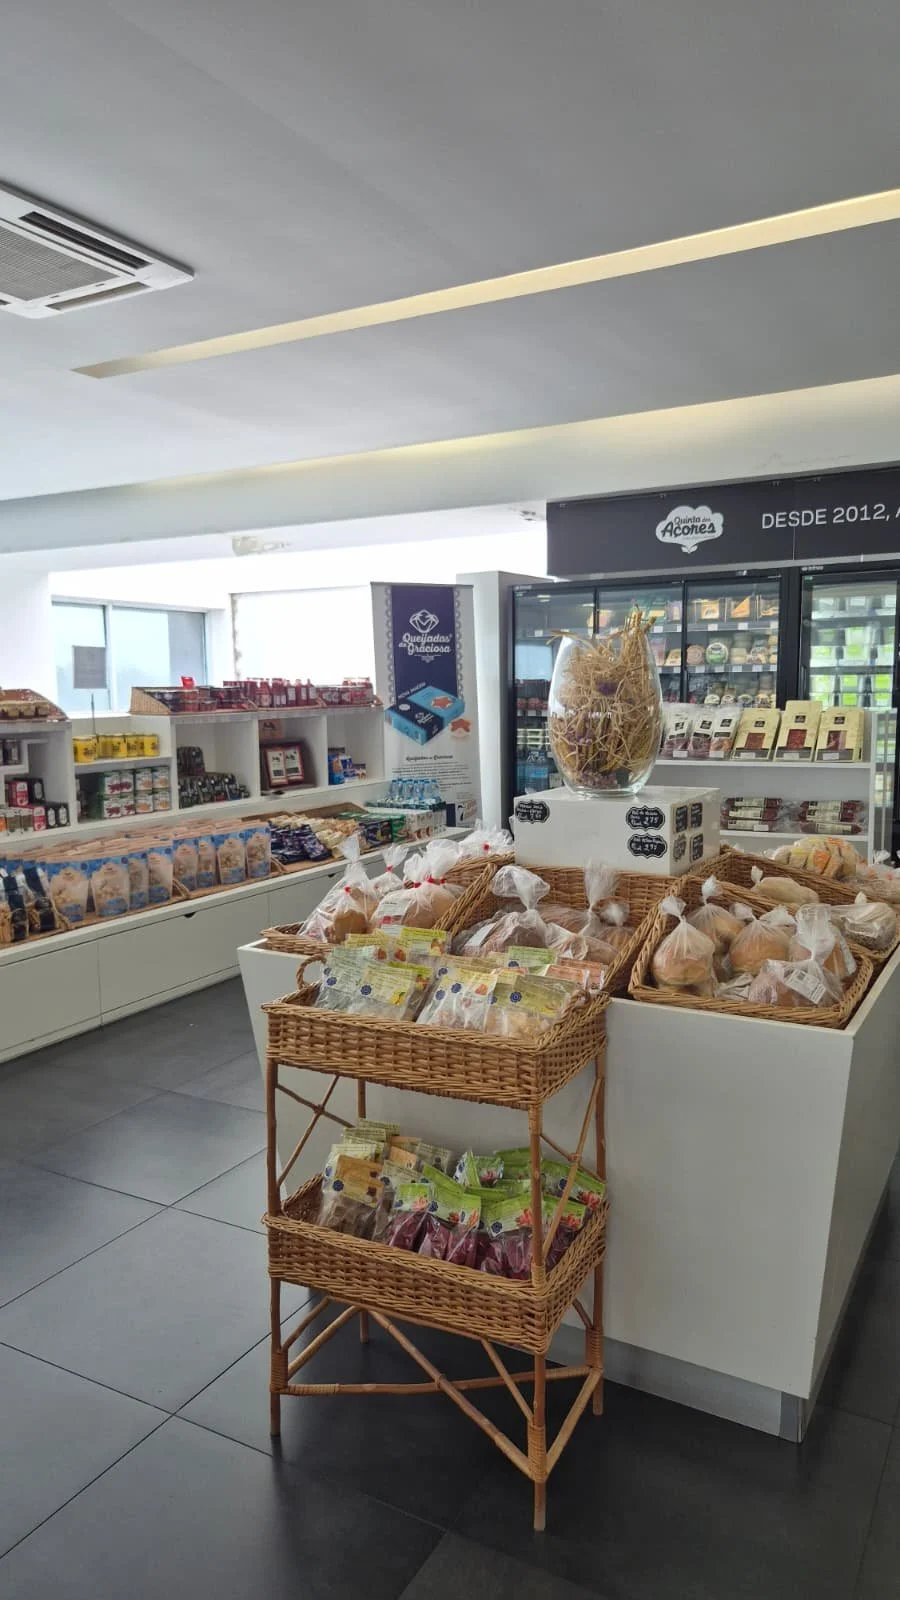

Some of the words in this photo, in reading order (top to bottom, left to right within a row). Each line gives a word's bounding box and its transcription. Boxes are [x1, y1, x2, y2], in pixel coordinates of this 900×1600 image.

[761, 508, 827, 529] DESDE
[832, 503, 890, 522] 2012,
[660, 521, 717, 538] Açores
[407, 643, 451, 656] Graciosa
